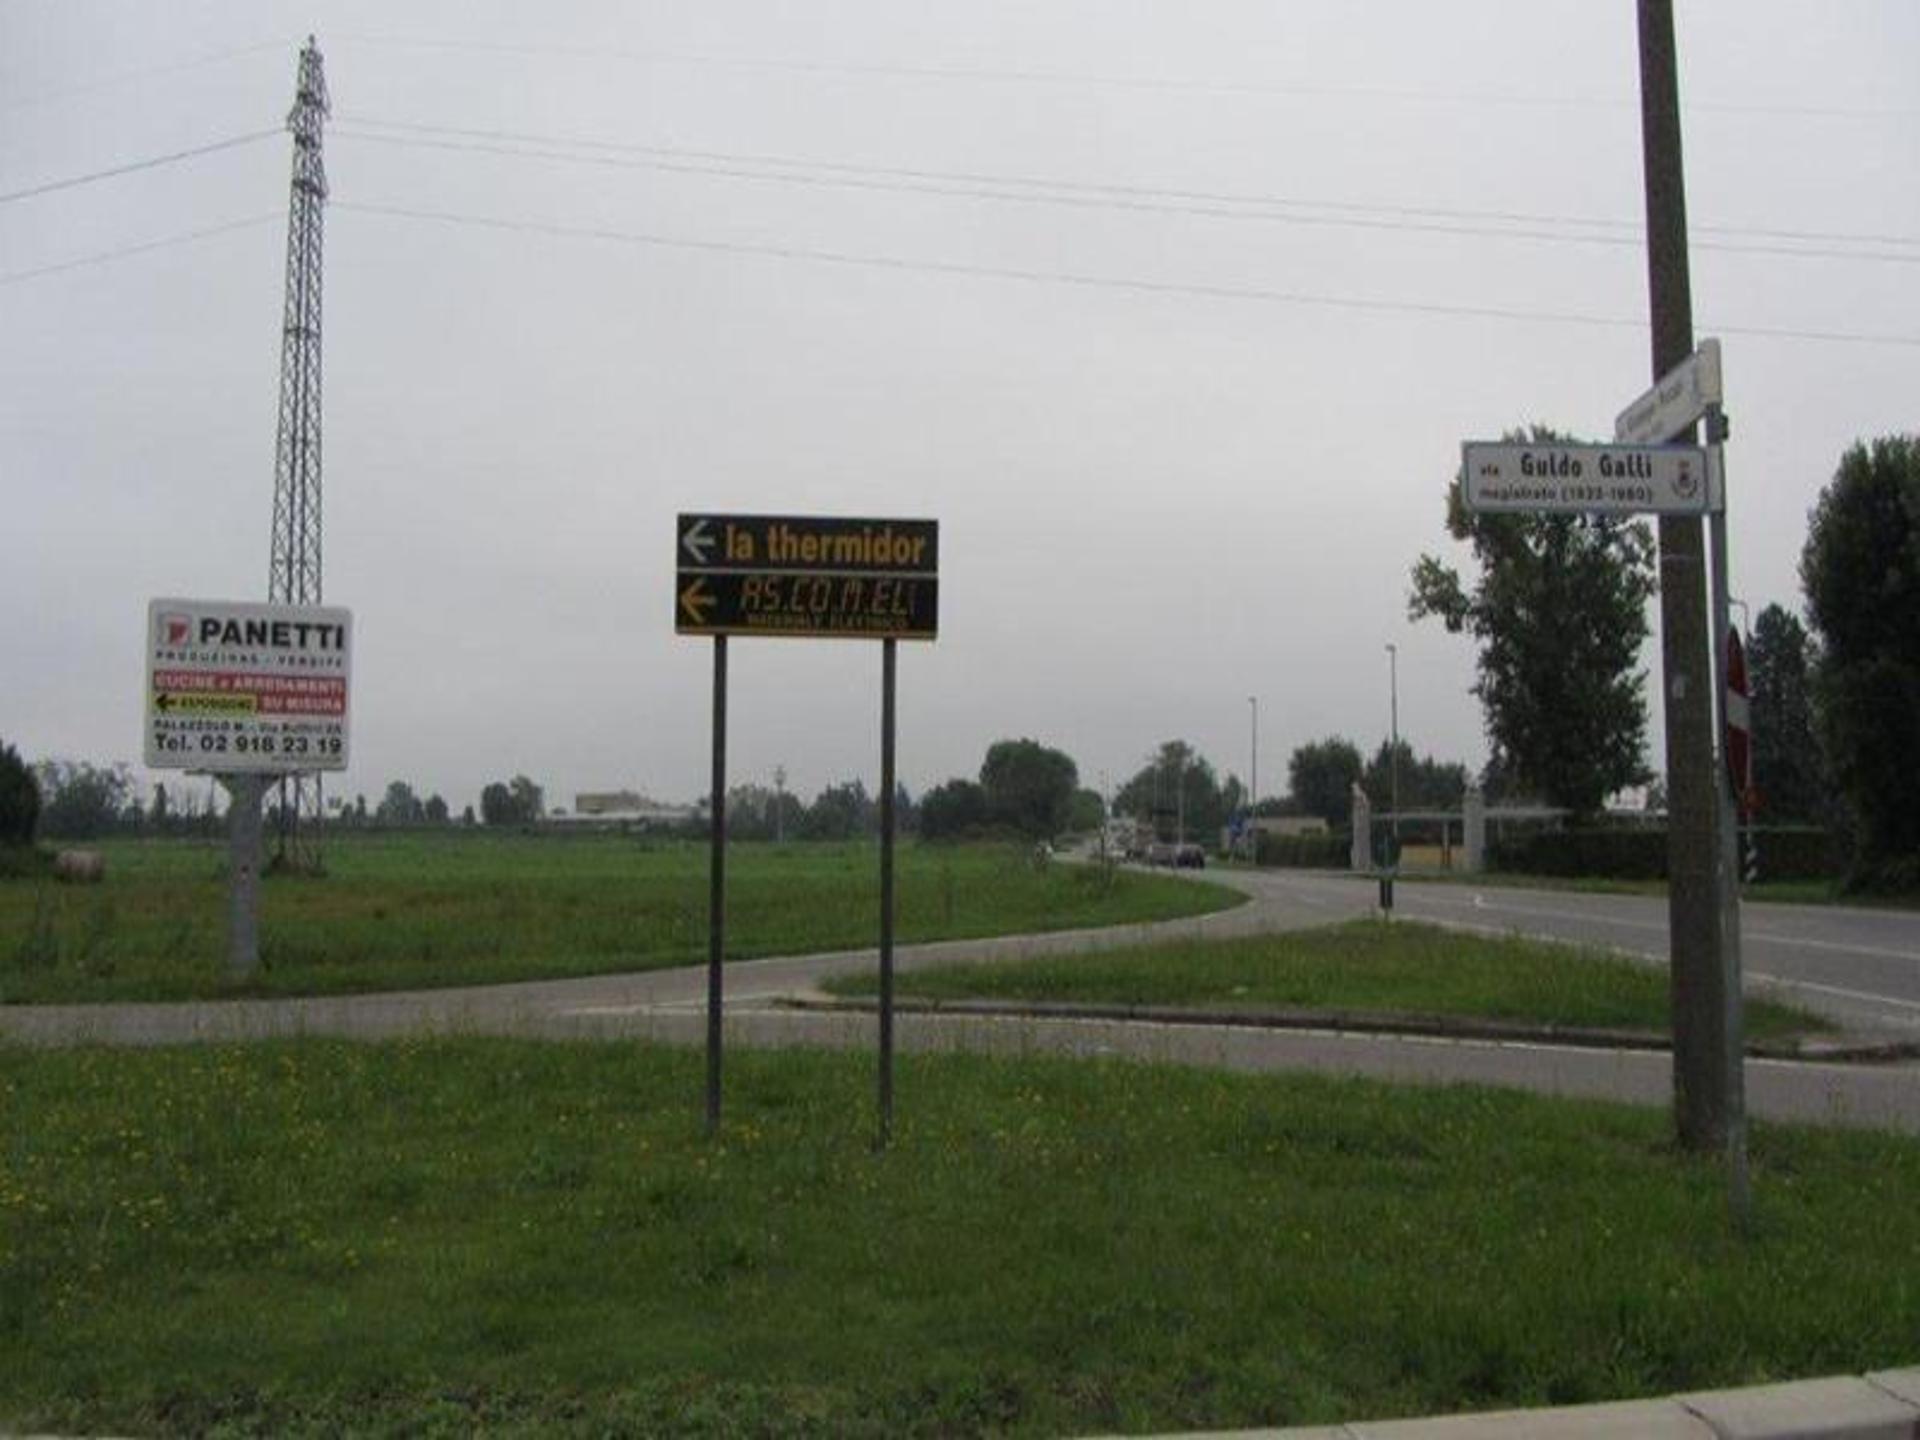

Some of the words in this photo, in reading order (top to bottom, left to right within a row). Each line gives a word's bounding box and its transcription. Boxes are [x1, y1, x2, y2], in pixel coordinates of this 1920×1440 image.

[1520, 452, 1583, 478] Guido
[1600, 452, 1652, 479] Galli
[726, 524, 754, 561] la
[768, 524, 927, 564] thermidor
[201, 618, 345, 650] PANETTI
[154, 733, 193, 751] Tel.
[201, 734, 228, 752] 02
[235, 735, 275, 753] 918
[282, 736, 308, 753] 23
[317, 738, 342, 754] 19
